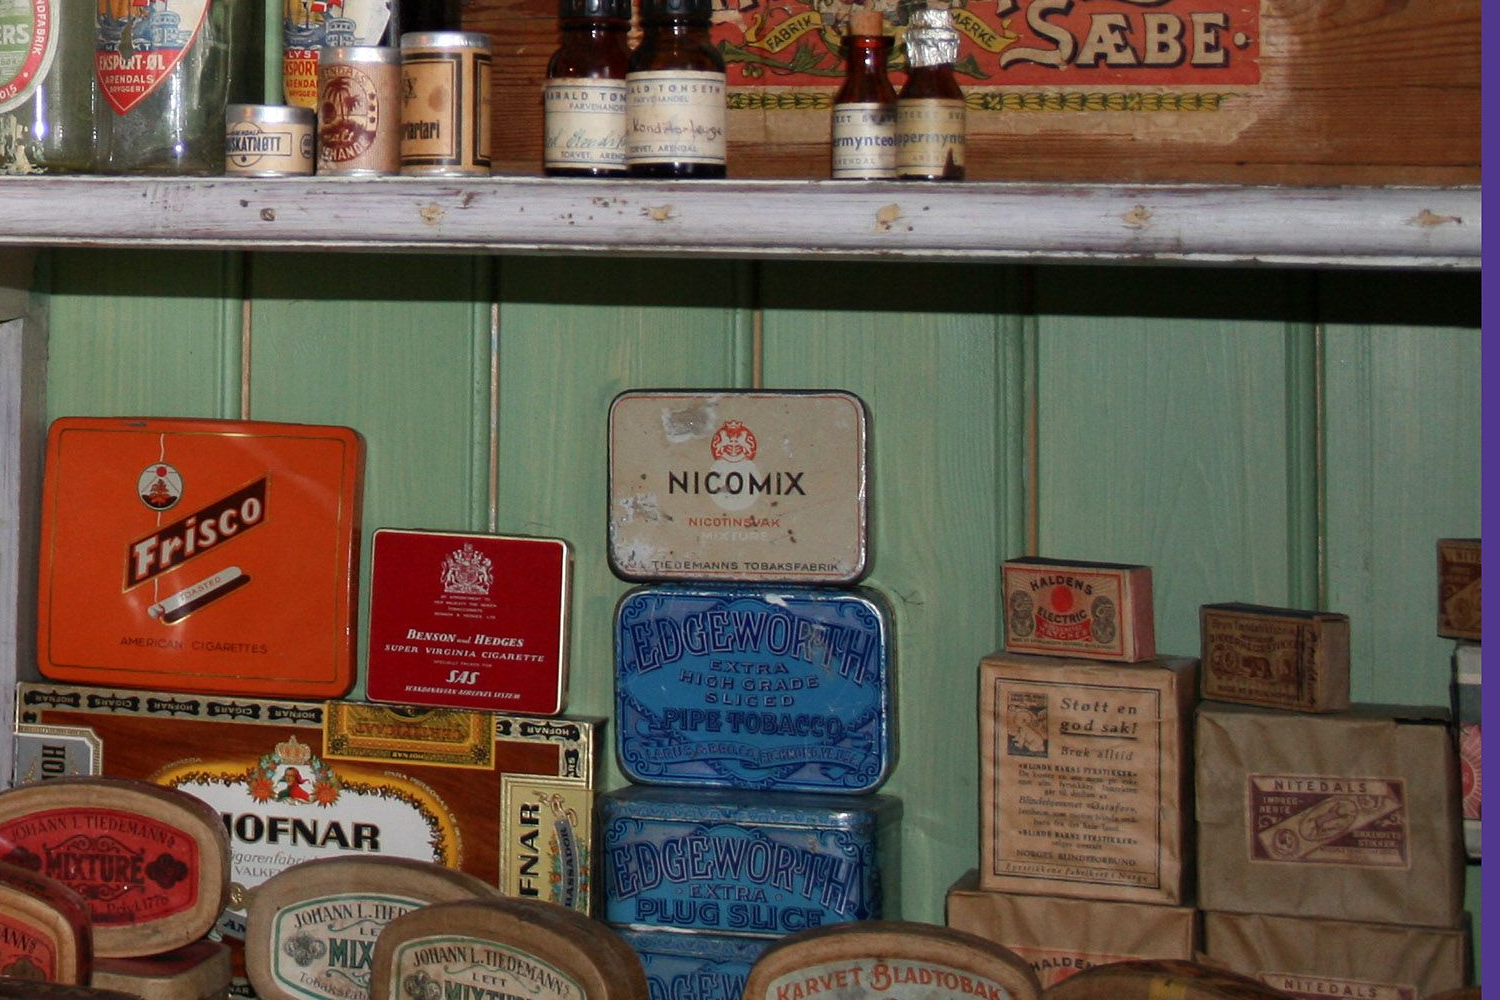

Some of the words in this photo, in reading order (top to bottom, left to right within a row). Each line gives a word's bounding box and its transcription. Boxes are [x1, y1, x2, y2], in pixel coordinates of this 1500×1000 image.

[765, 15, 815, 52] FABRIK
[105, 74, 155, 85] ARENDALS
[668, 470, 807, 496] NICOMIX
[689, 515, 781, 528] NICOTINSVAK
[132, 496, 263, 581] Frisco
[651, 559, 739, 571] TIEDEMANNS
[744, 561, 839, 572] TOBAKSFABRIK
[1029, 575, 1094, 596] HALDENS
[1036, 606, 1088, 624] ELECTRIC
[119, 635, 184, 650] AMERICAN
[190, 640, 269, 655] CIGARETTES
[406, 628, 457, 644] BENSON
[474, 634, 526, 648] HEDGES
[629, 609, 878, 686] EDGEWORTH
[384, 644, 419, 654] SUPER
[425, 646, 477, 658] VIRGINIA
[481, 651, 546, 663] CIGARETTE
[446, 669, 480, 685] SAS
[709, 659, 790, 675] EXTRA
[679, 670, 734, 689] HIGH
[741, 675, 821, 691] GRADE
[704, 691, 796, 707] SLICED
[1117, 705, 1138, 716] en
[526, 726, 571, 737] HOFNAR
[661, 706, 722, 732] PIPE
[727, 709, 845, 739] TOBACCO
[1060, 719, 1095, 735] god
[1101, 720, 1139, 736] sak!
[1274, 779, 1368, 794] NITEDALS
[45, 852, 146, 885] MIXTURE
[609, 836, 858, 915] EDGEWORTH
[689, 884, 768, 902] EXTRA
[293, 903, 353, 929] JOHANN
[634, 900, 720, 925] PLUG
[727, 905, 825, 930] SLICE
[328, 937, 374, 970] MIX
[413, 945, 467, 968] JOHANN
[472, 971, 508, 988] LETT
[775, 967, 863, 1000] KARVET
[869, 963, 1002, 1000] BLADTOBAK
[1282, 976, 1379, 999] NITEDALS
